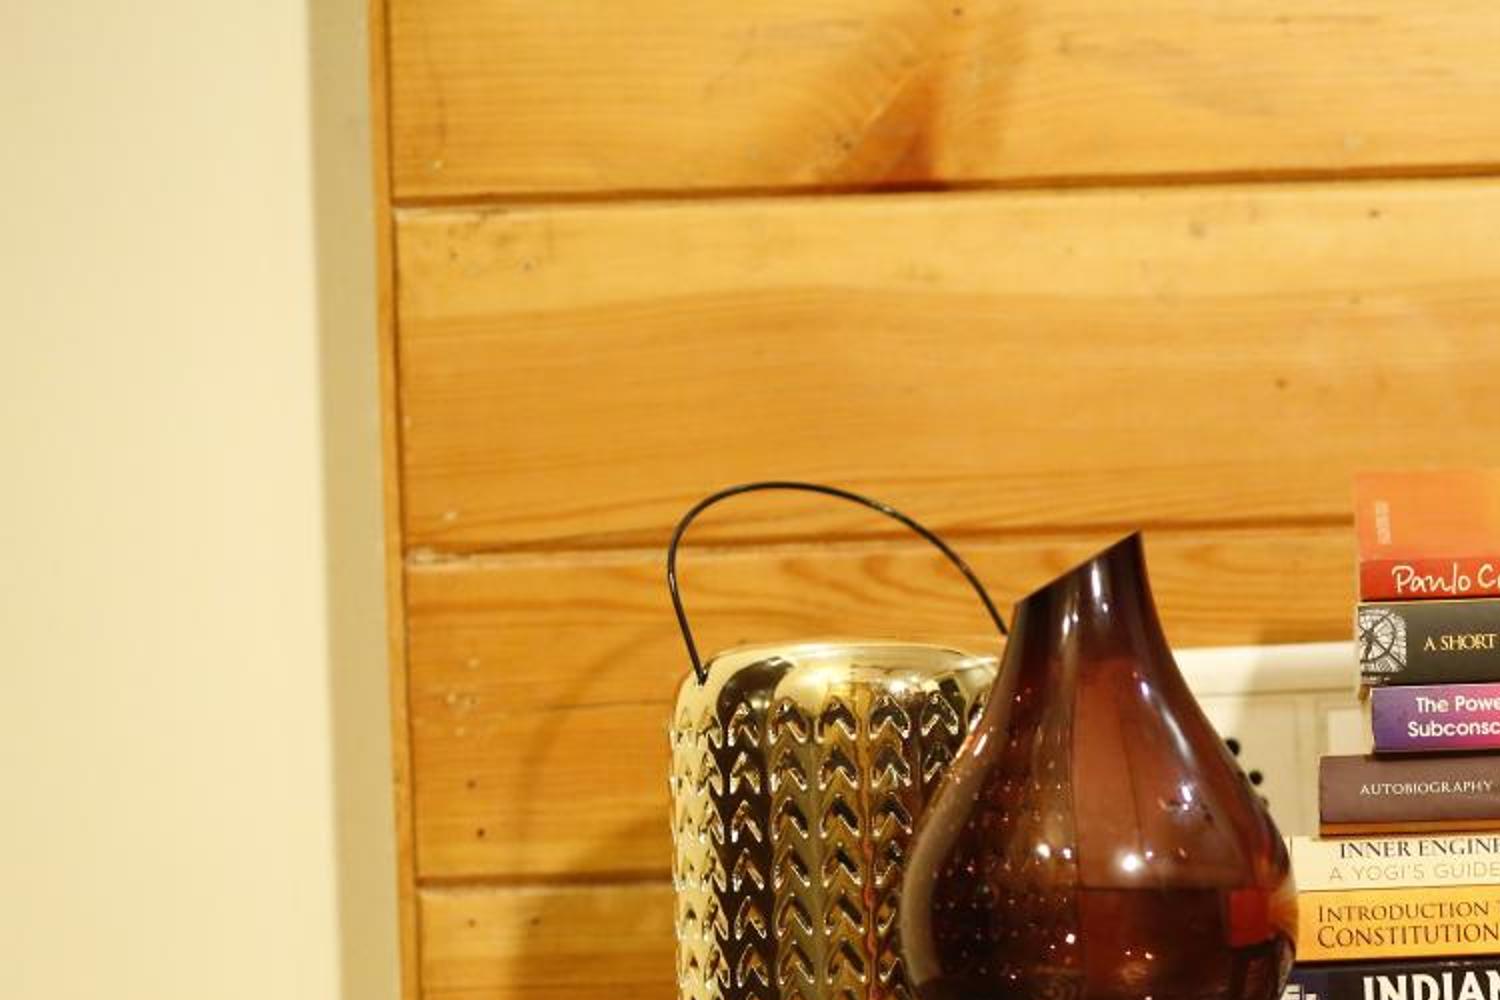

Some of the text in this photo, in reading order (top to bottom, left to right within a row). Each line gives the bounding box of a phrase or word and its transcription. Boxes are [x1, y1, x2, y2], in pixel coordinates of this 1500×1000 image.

[1391, 560, 1471, 592] Paulo
[1424, 638, 1437, 651] A
[1441, 633, 1496, 650] SHORT
[1416, 696, 1449, 713] The
[1360, 779, 1492, 795] AUTOBIOGRAPHY
[1340, 841, 1411, 859] INNER
[1329, 868, 1343, 882] A
[1351, 863, 1425, 881] YOGI'S
[1434, 861, 1500, 879] GUIDE
[1319, 901, 1489, 922] INTRODUCTION
[1317, 923, 1499, 948] CONSTITUTION
